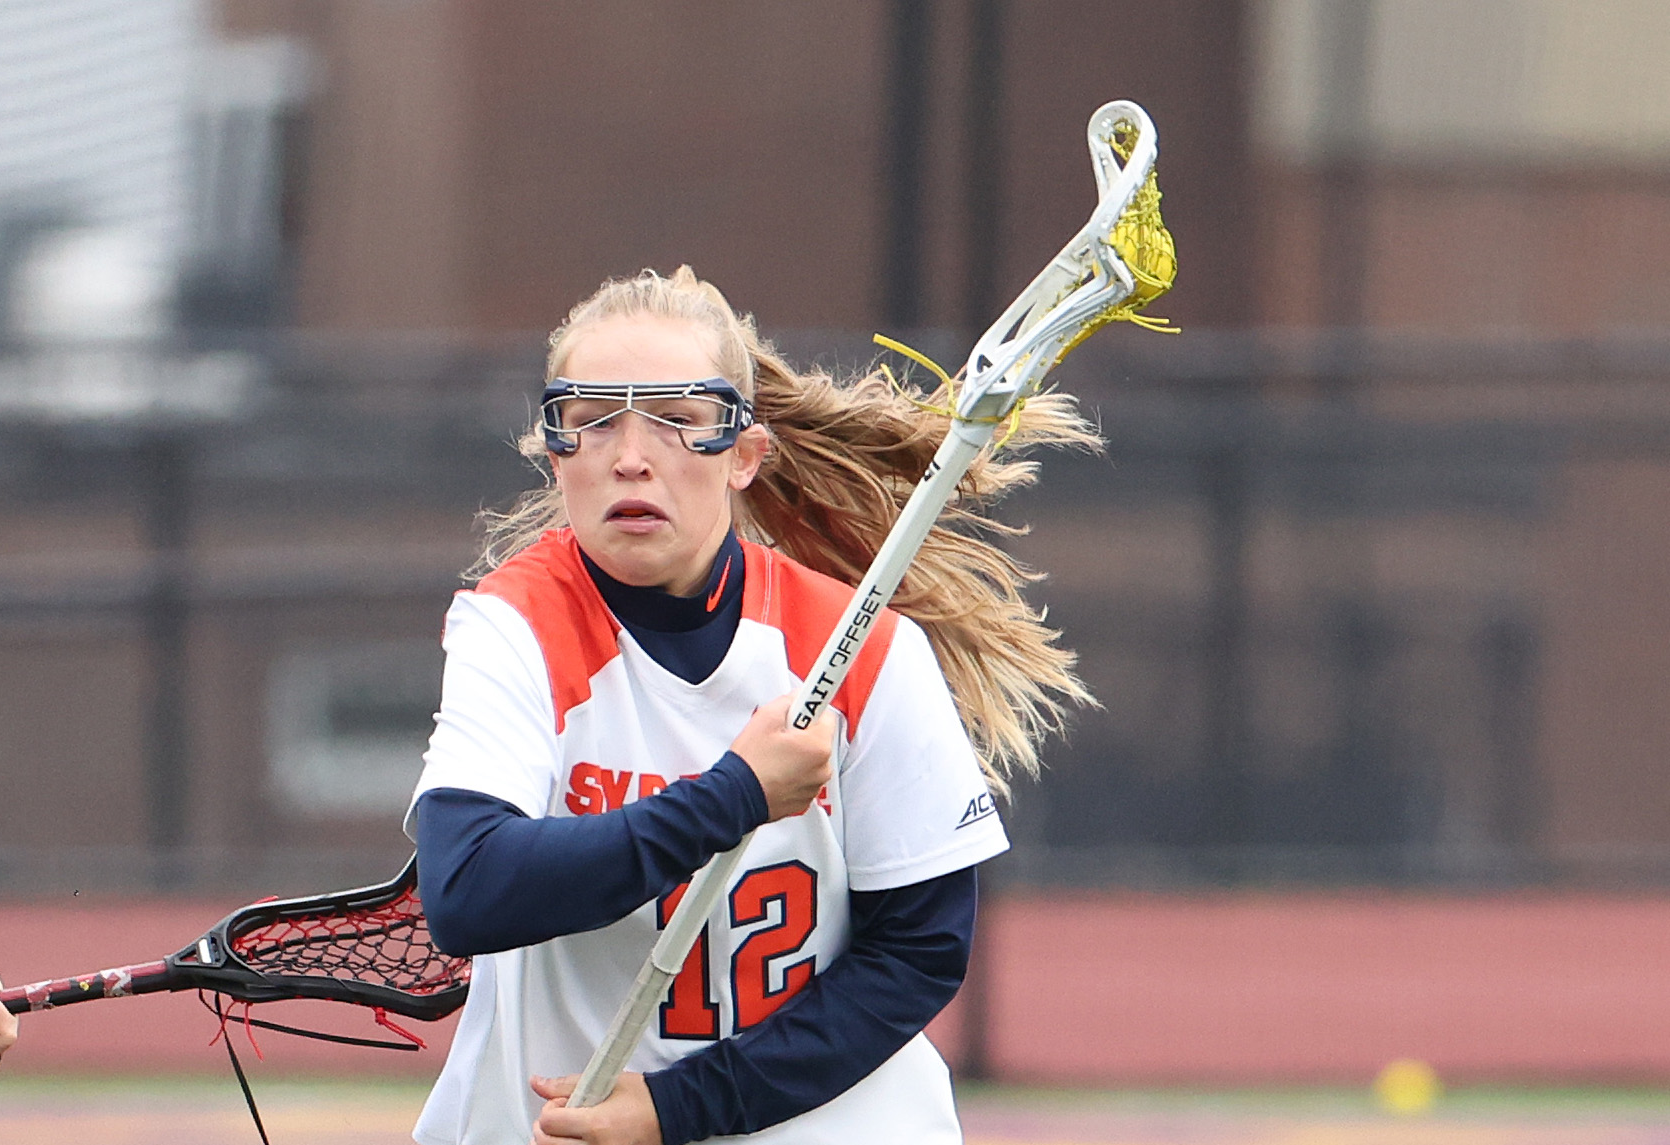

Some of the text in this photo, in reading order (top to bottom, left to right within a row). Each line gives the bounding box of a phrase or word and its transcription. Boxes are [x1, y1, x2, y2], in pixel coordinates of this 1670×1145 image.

[792, 584, 884, 731] GAIT OFFSET
[656, 859, 818, 1040] 12
